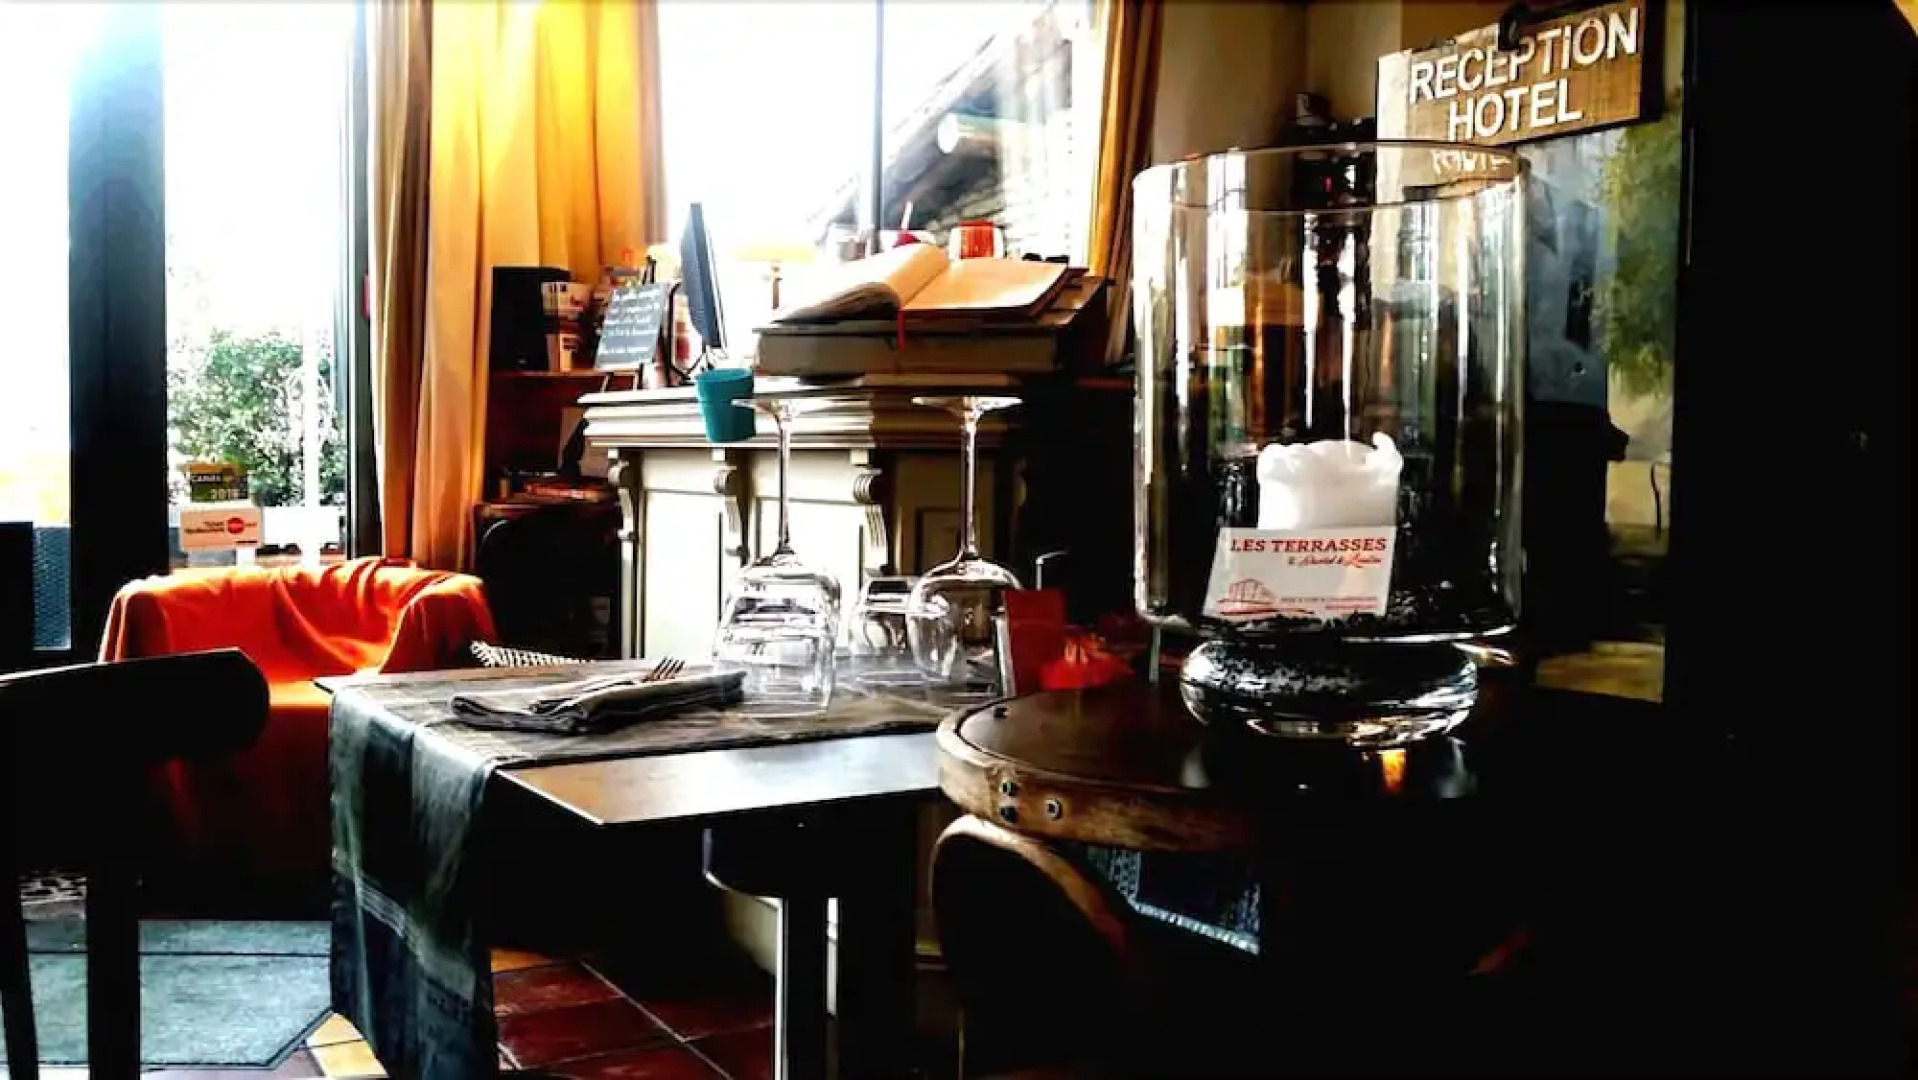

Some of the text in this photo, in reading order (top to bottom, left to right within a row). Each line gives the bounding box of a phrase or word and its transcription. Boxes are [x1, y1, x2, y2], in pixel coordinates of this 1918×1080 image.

[1449, 77, 1583, 142] HOTEL
[1230, 538, 1388, 553] LES TERRASSES
